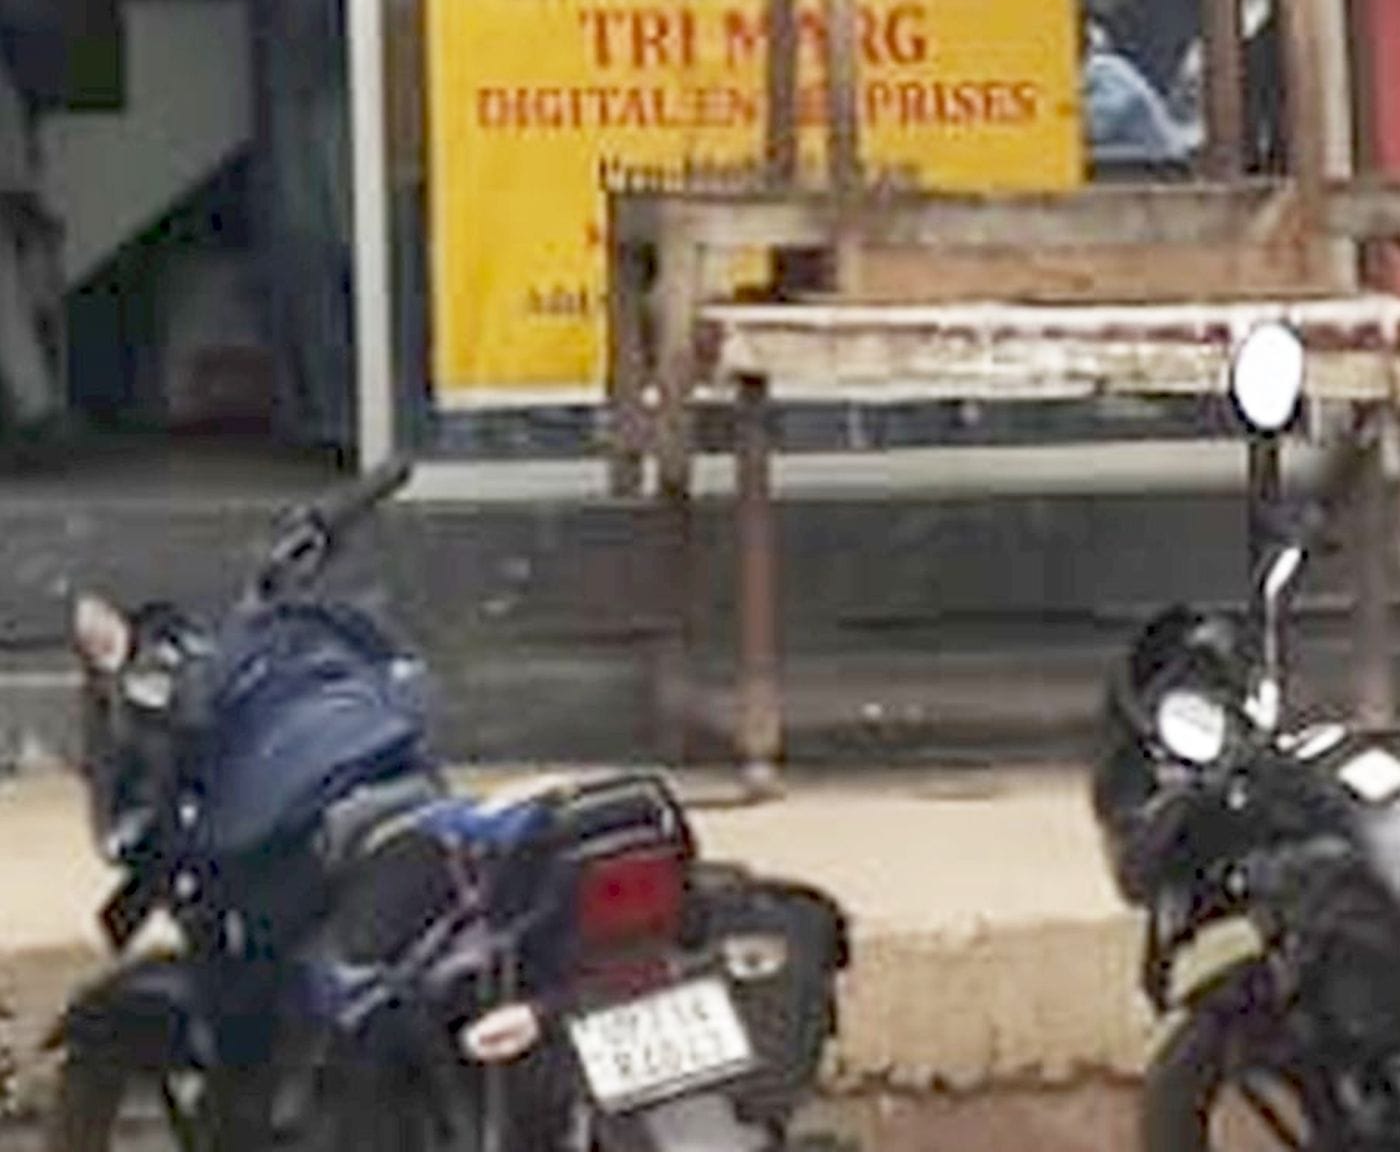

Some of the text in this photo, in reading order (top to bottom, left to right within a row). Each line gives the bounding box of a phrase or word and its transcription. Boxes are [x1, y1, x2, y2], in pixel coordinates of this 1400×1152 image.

[578, 8, 695, 69] TRI
[477, 79, 1038, 129] DIGITAL ENEPRISES
